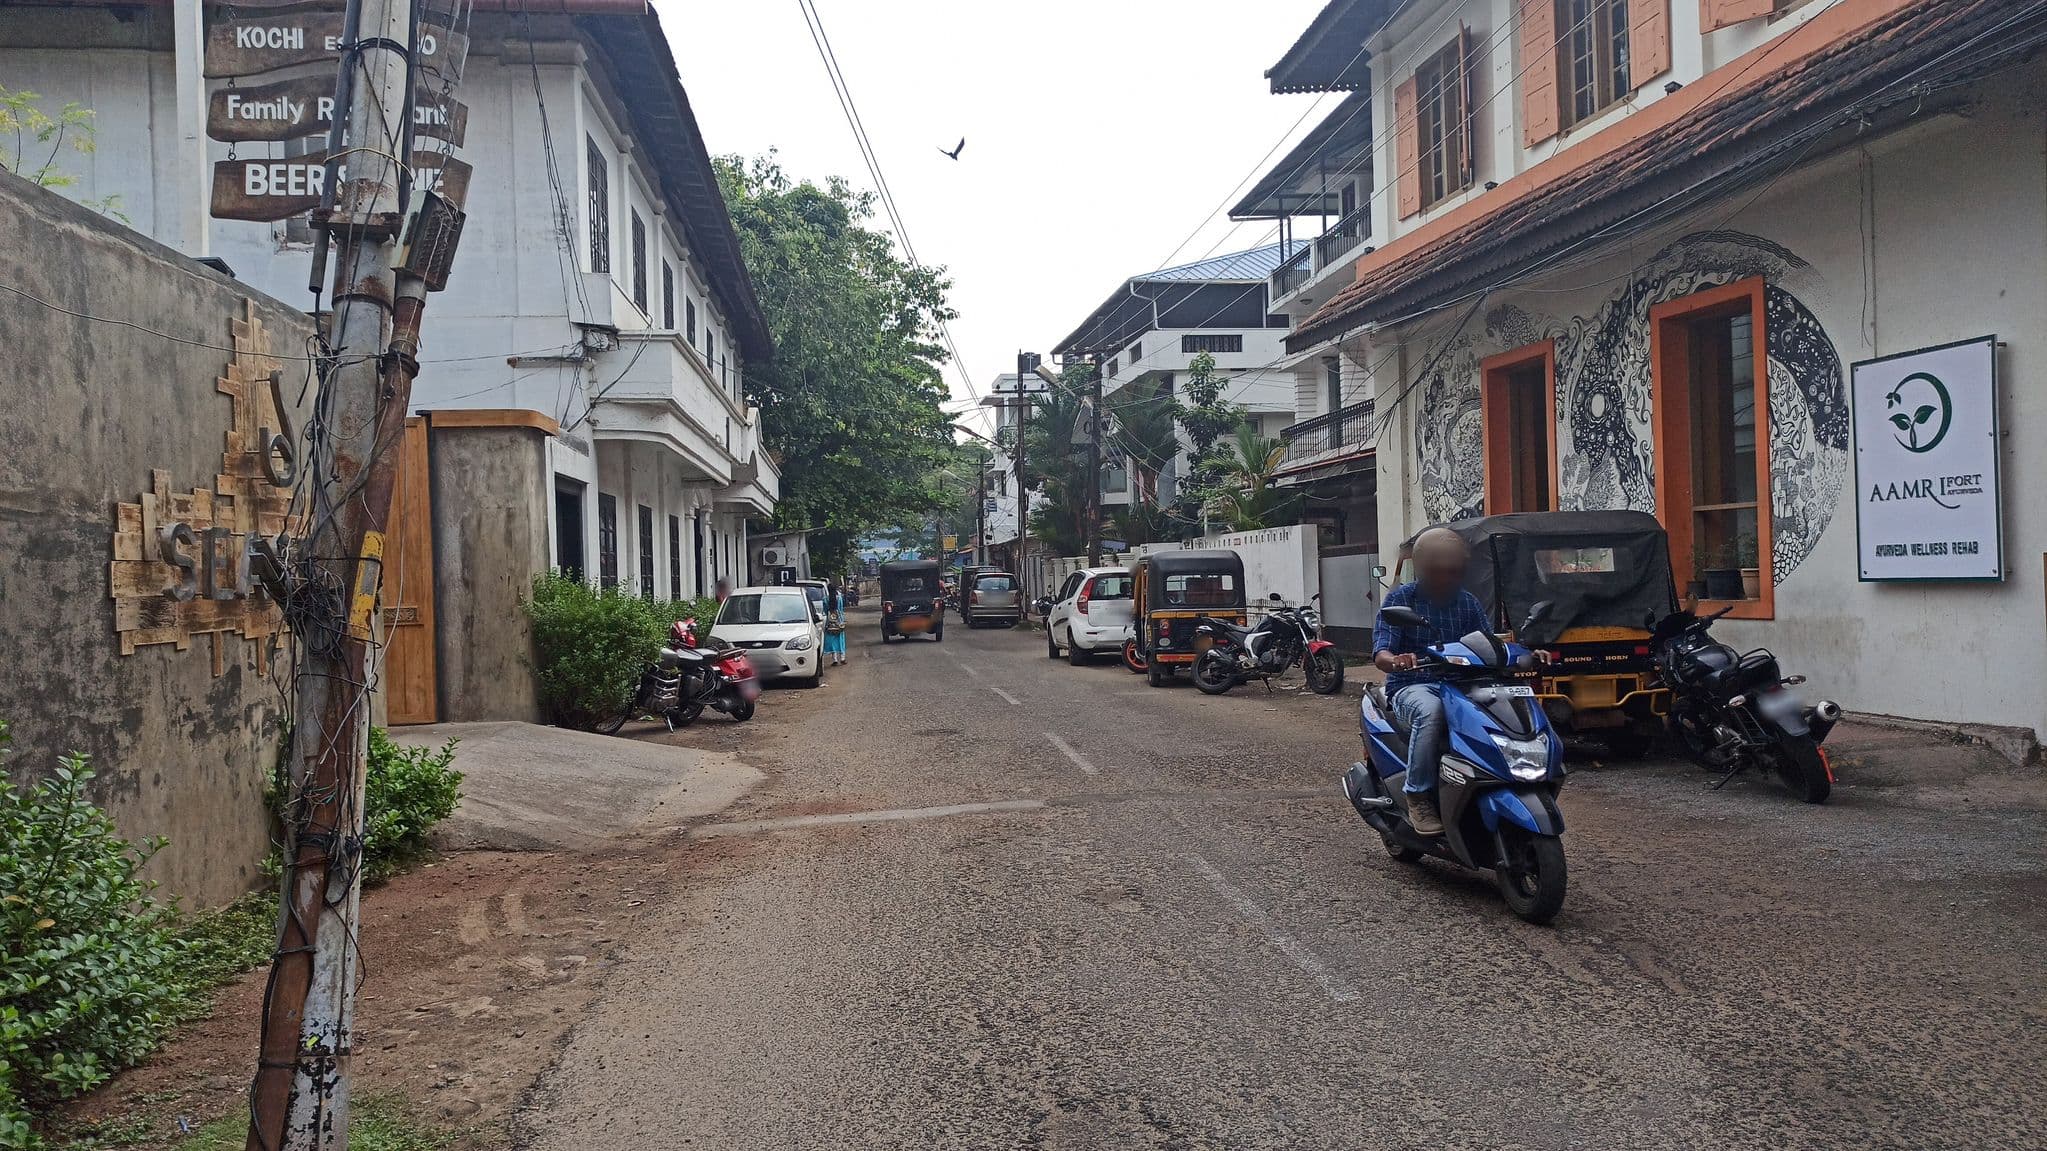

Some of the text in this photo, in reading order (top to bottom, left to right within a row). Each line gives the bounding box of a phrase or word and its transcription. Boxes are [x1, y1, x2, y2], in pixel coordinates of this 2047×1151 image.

[236, 26, 304, 50] KOCHI
[227, 94, 305, 125] Family
[245, 163, 327, 196] BEER
[1946, 473, 1983, 488] FORT
[1875, 541, 1979, 557] AYURVEDA WELLNESS REHAB
[1604, 654, 1629, 662] HORN
